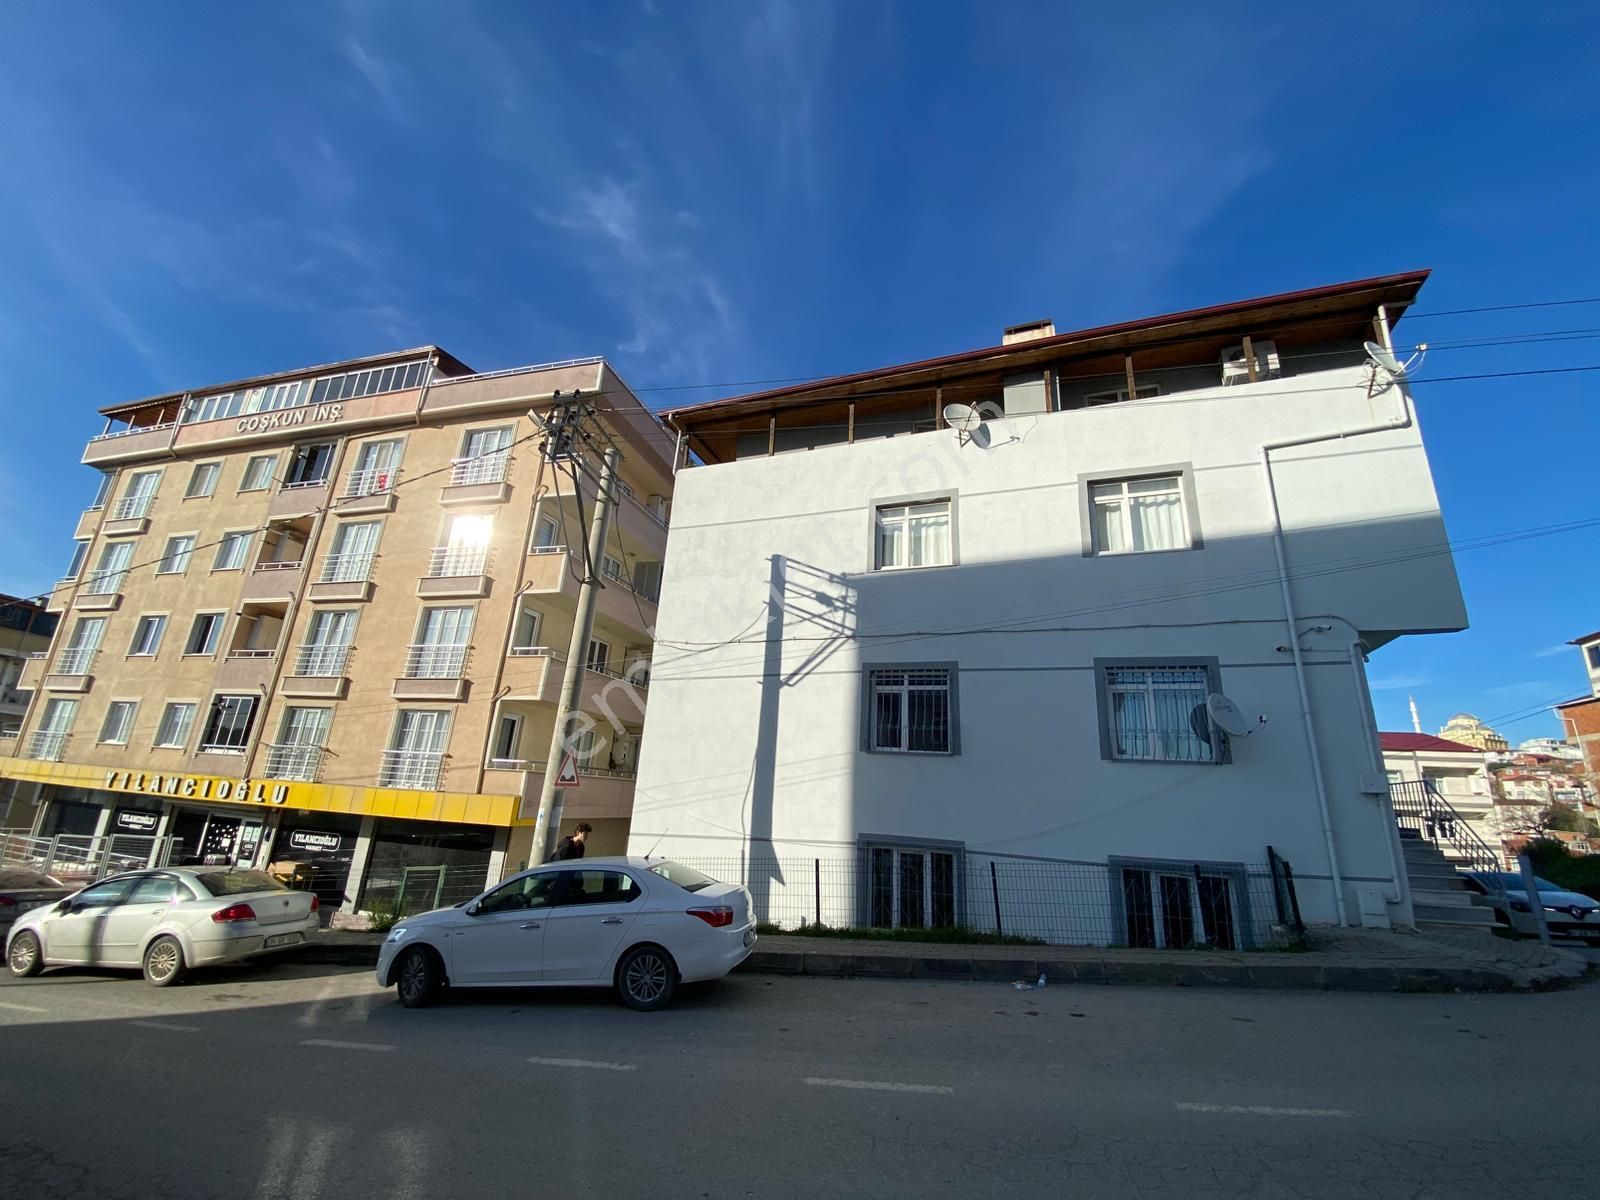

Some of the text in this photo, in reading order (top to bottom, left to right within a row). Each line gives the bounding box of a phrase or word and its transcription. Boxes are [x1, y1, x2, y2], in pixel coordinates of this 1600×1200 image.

[236, 409, 307, 433] COŞKUN
[106, 771, 288, 804] YILANCIOĞLU
[295, 833, 338, 846] YILANCIOĞLU
